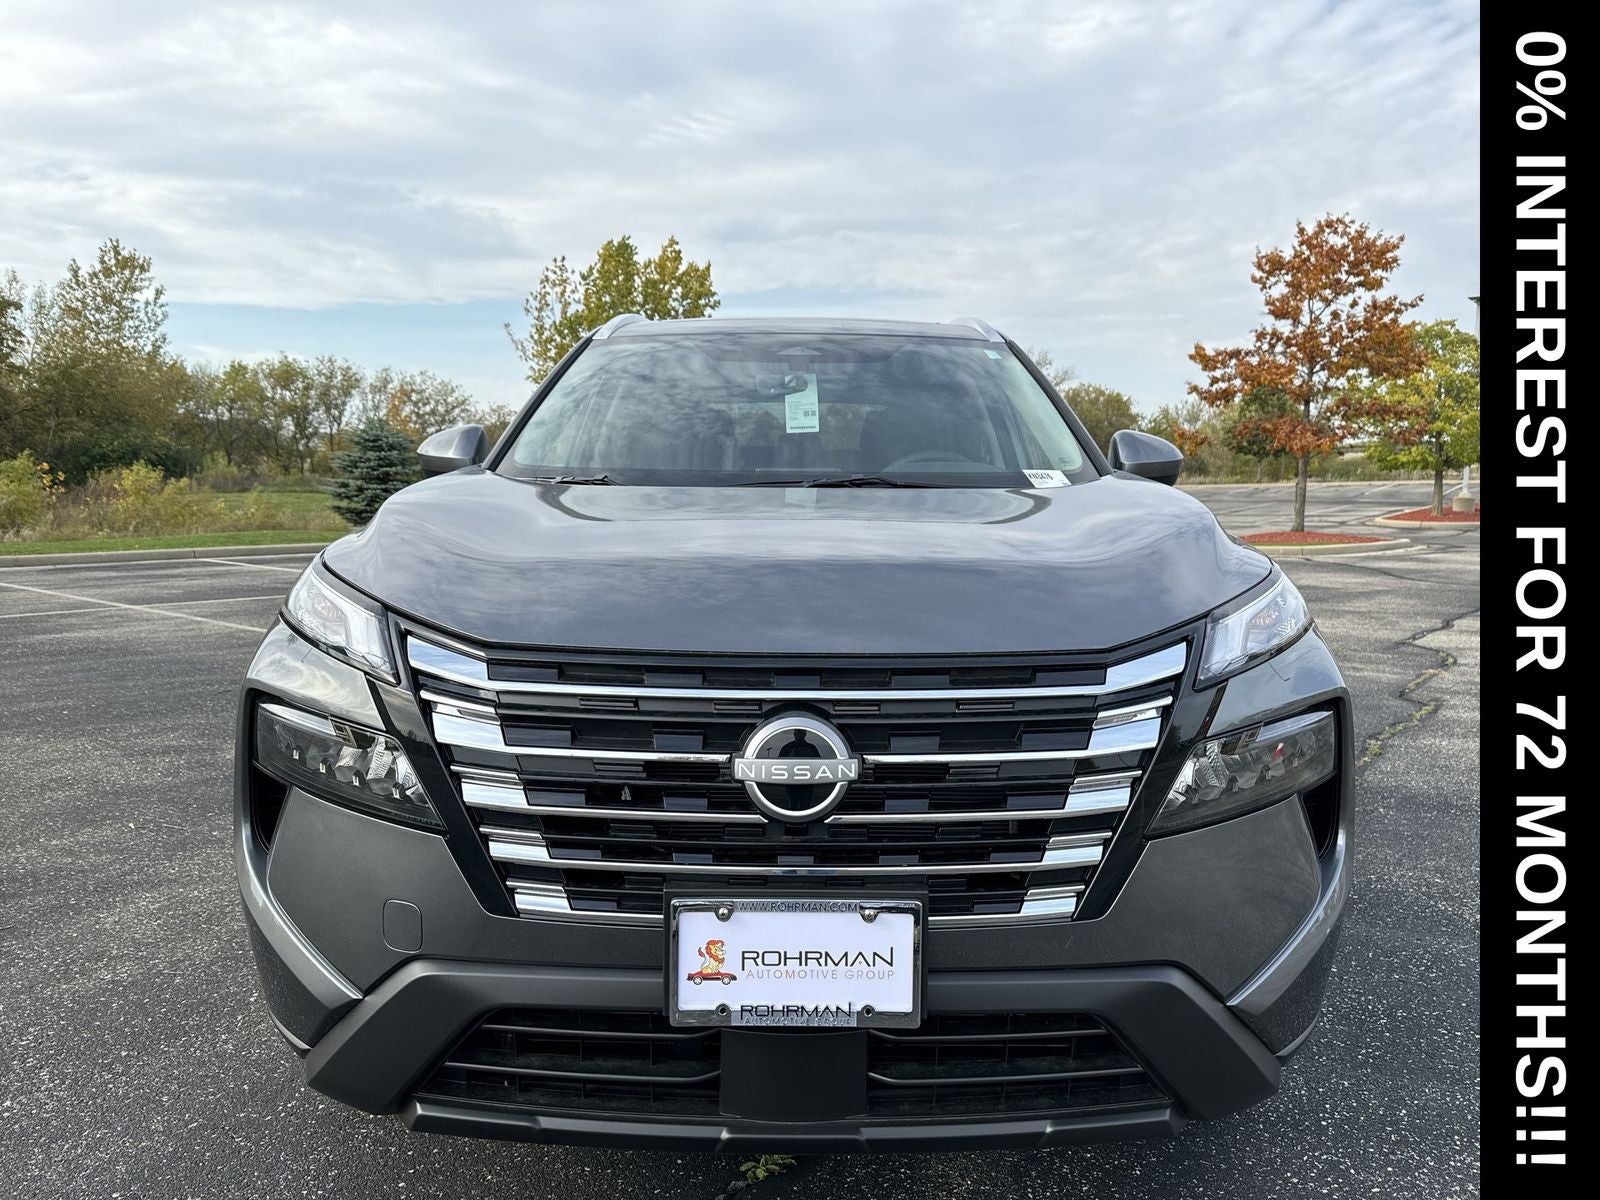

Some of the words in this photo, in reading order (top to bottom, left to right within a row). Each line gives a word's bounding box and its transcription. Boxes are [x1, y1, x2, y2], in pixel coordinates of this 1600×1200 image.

[739, 763, 855, 780] NISSAN
[739, 901, 857, 913] WWW.ROHRMAN.COM
[741, 946, 893, 971] ROHRMAN
[746, 969, 838, 979] AUTOMOTIVE
[844, 970, 894, 980] GROUP
[740, 1001, 851, 1020] ROHRMAN
